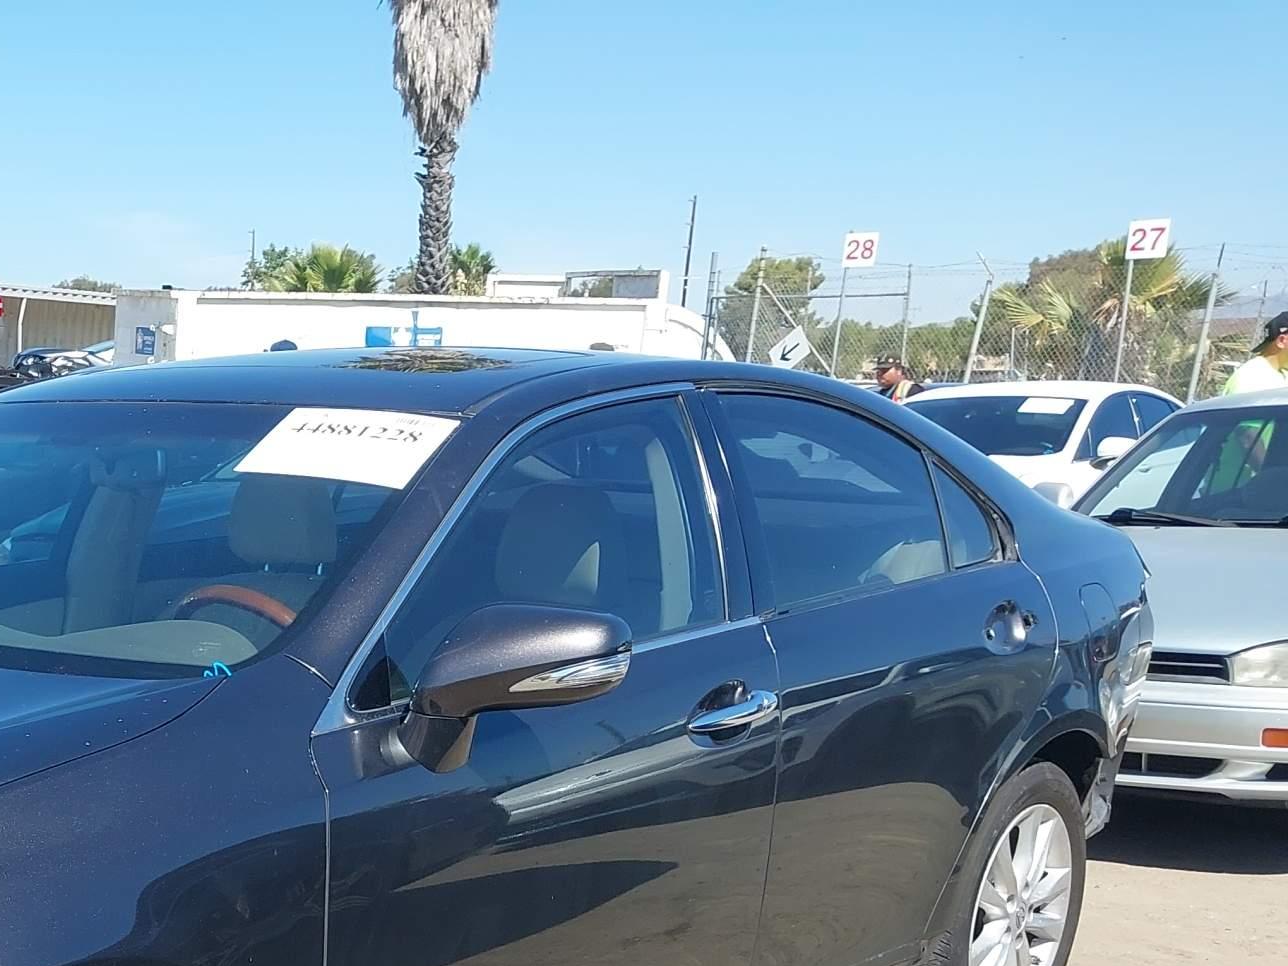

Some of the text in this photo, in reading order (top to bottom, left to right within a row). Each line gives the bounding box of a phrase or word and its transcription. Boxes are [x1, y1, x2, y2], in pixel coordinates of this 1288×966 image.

[846, 239, 874, 260] 28
[1130, 227, 1166, 251] 27
[291, 421, 423, 443] 44881228
